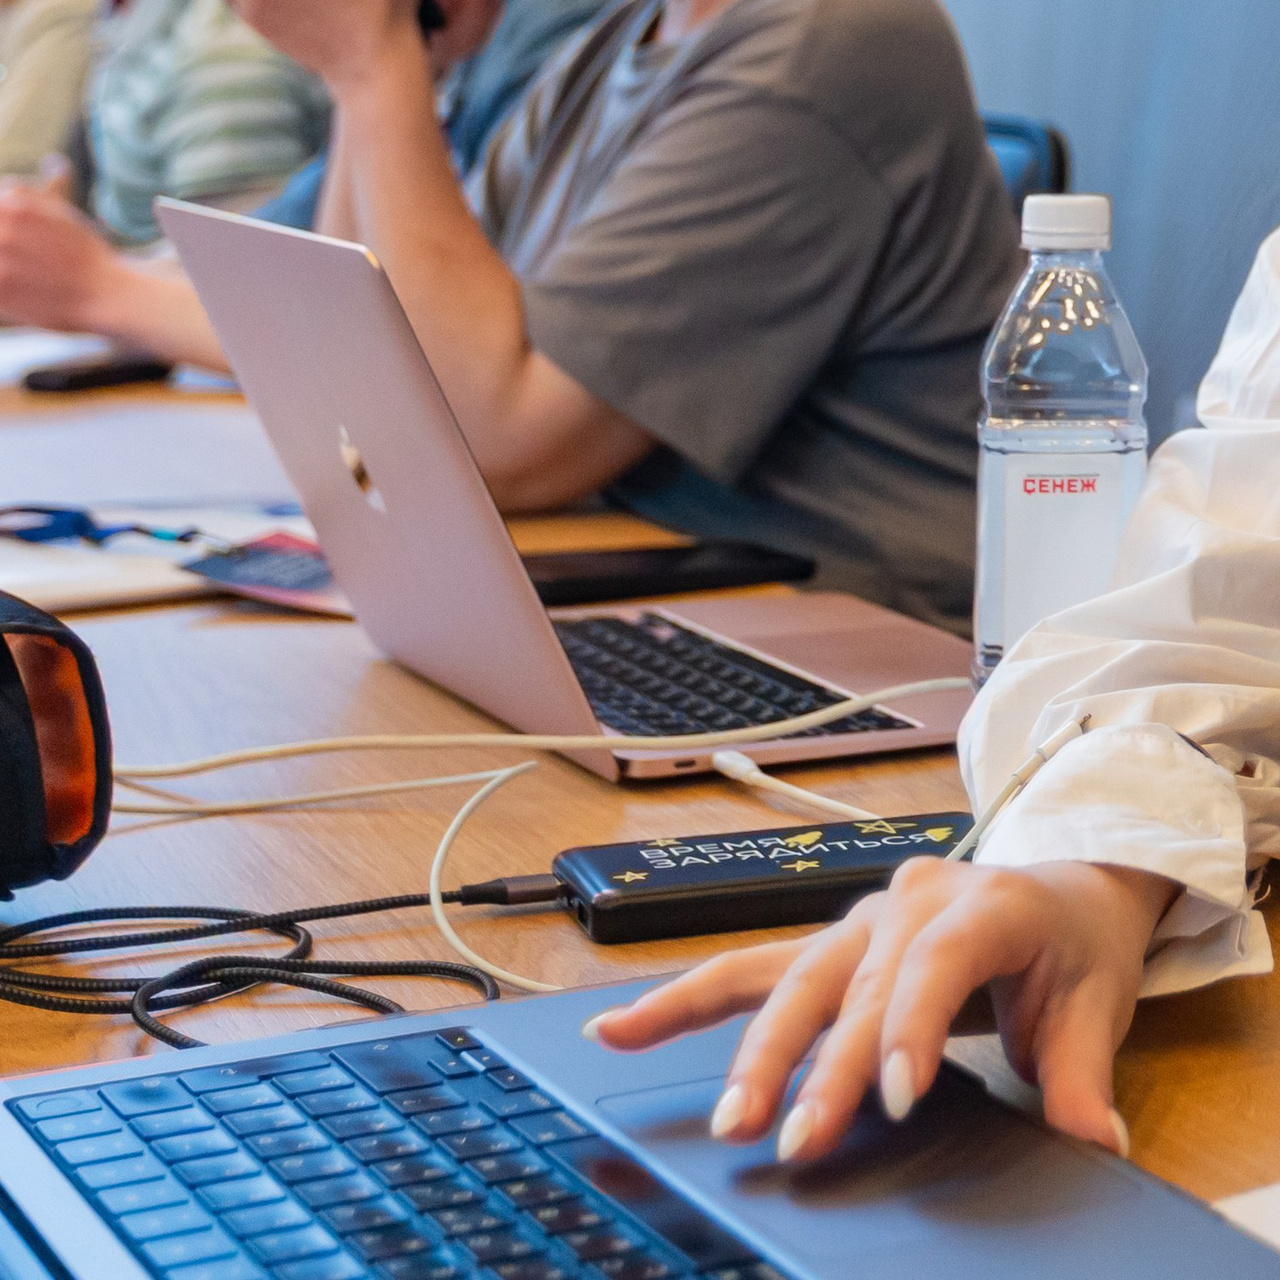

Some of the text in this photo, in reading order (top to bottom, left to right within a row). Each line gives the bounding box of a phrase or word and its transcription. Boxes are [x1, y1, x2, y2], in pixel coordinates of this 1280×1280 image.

[1023, 479, 1096, 494] СЕНЕЖ
[639, 836, 787, 859] ВРЕМЯ
[649, 832, 937, 869] ЗАРЯДИТЬСЯ
